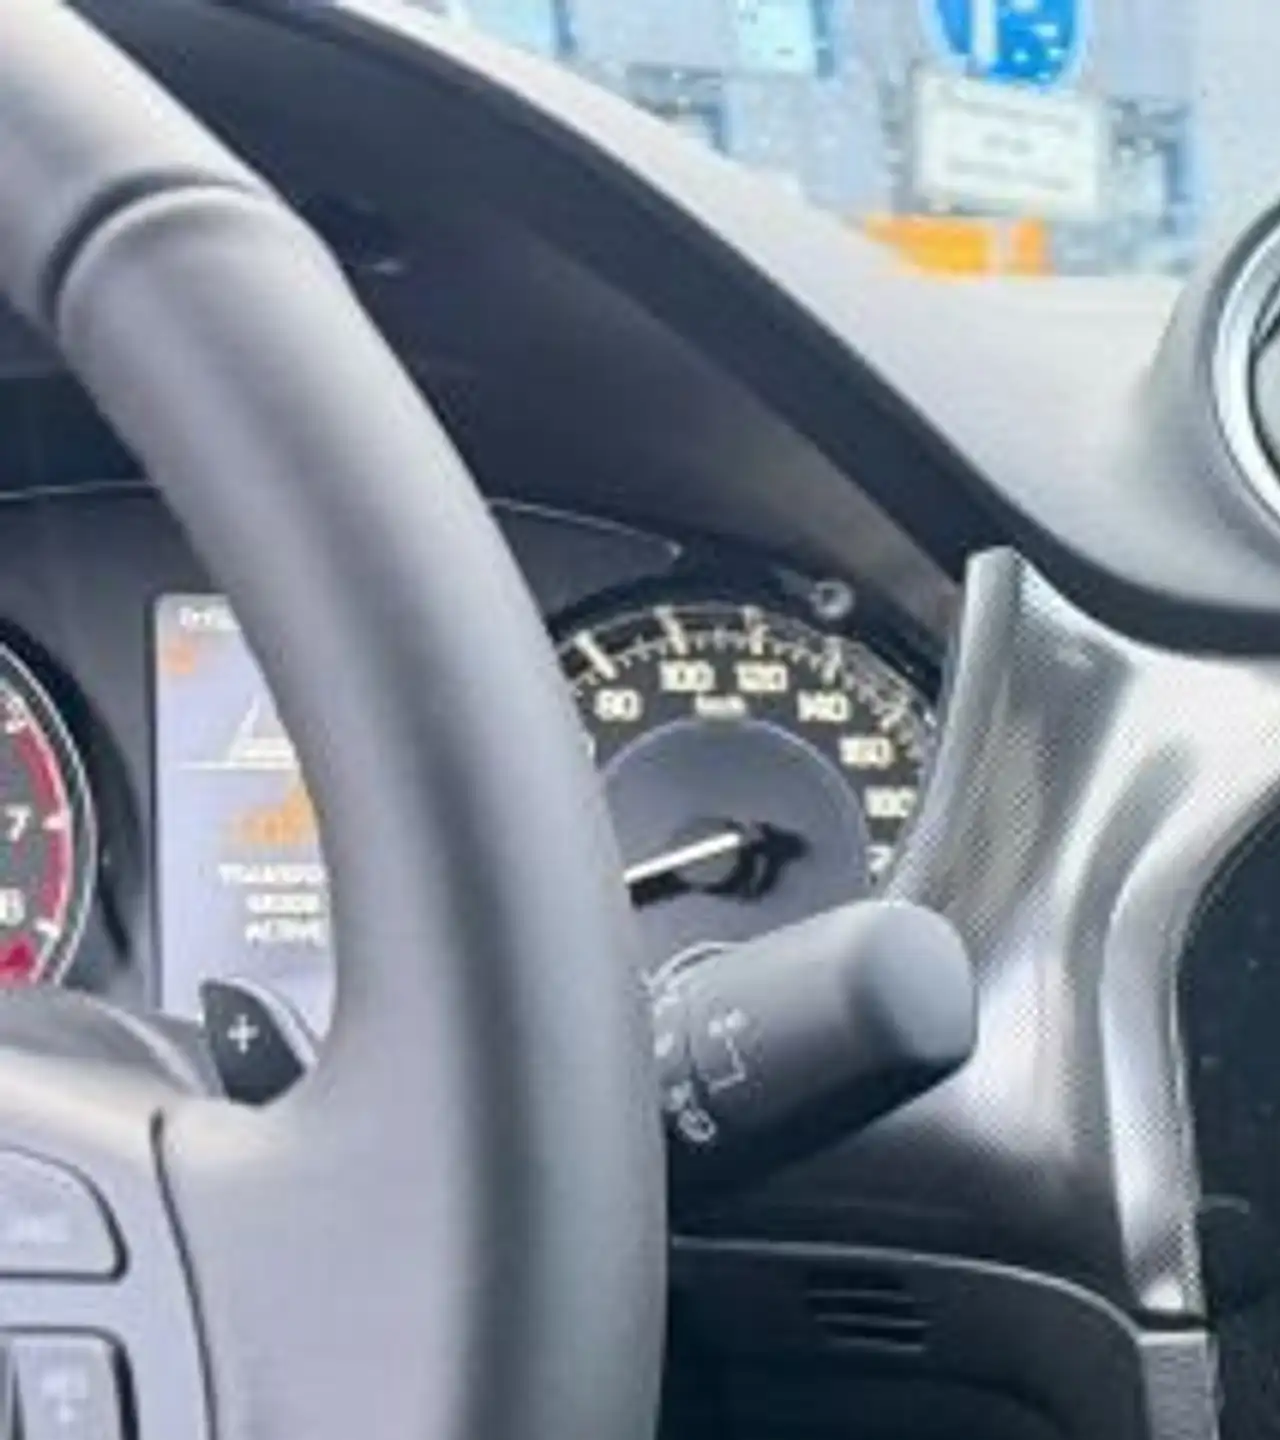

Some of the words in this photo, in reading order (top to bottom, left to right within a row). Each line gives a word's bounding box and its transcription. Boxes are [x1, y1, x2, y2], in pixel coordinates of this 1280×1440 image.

[658, 660, 715, 692] 100
[734, 661, 788, 693] 120
[6, 805, 30, 841] 7
